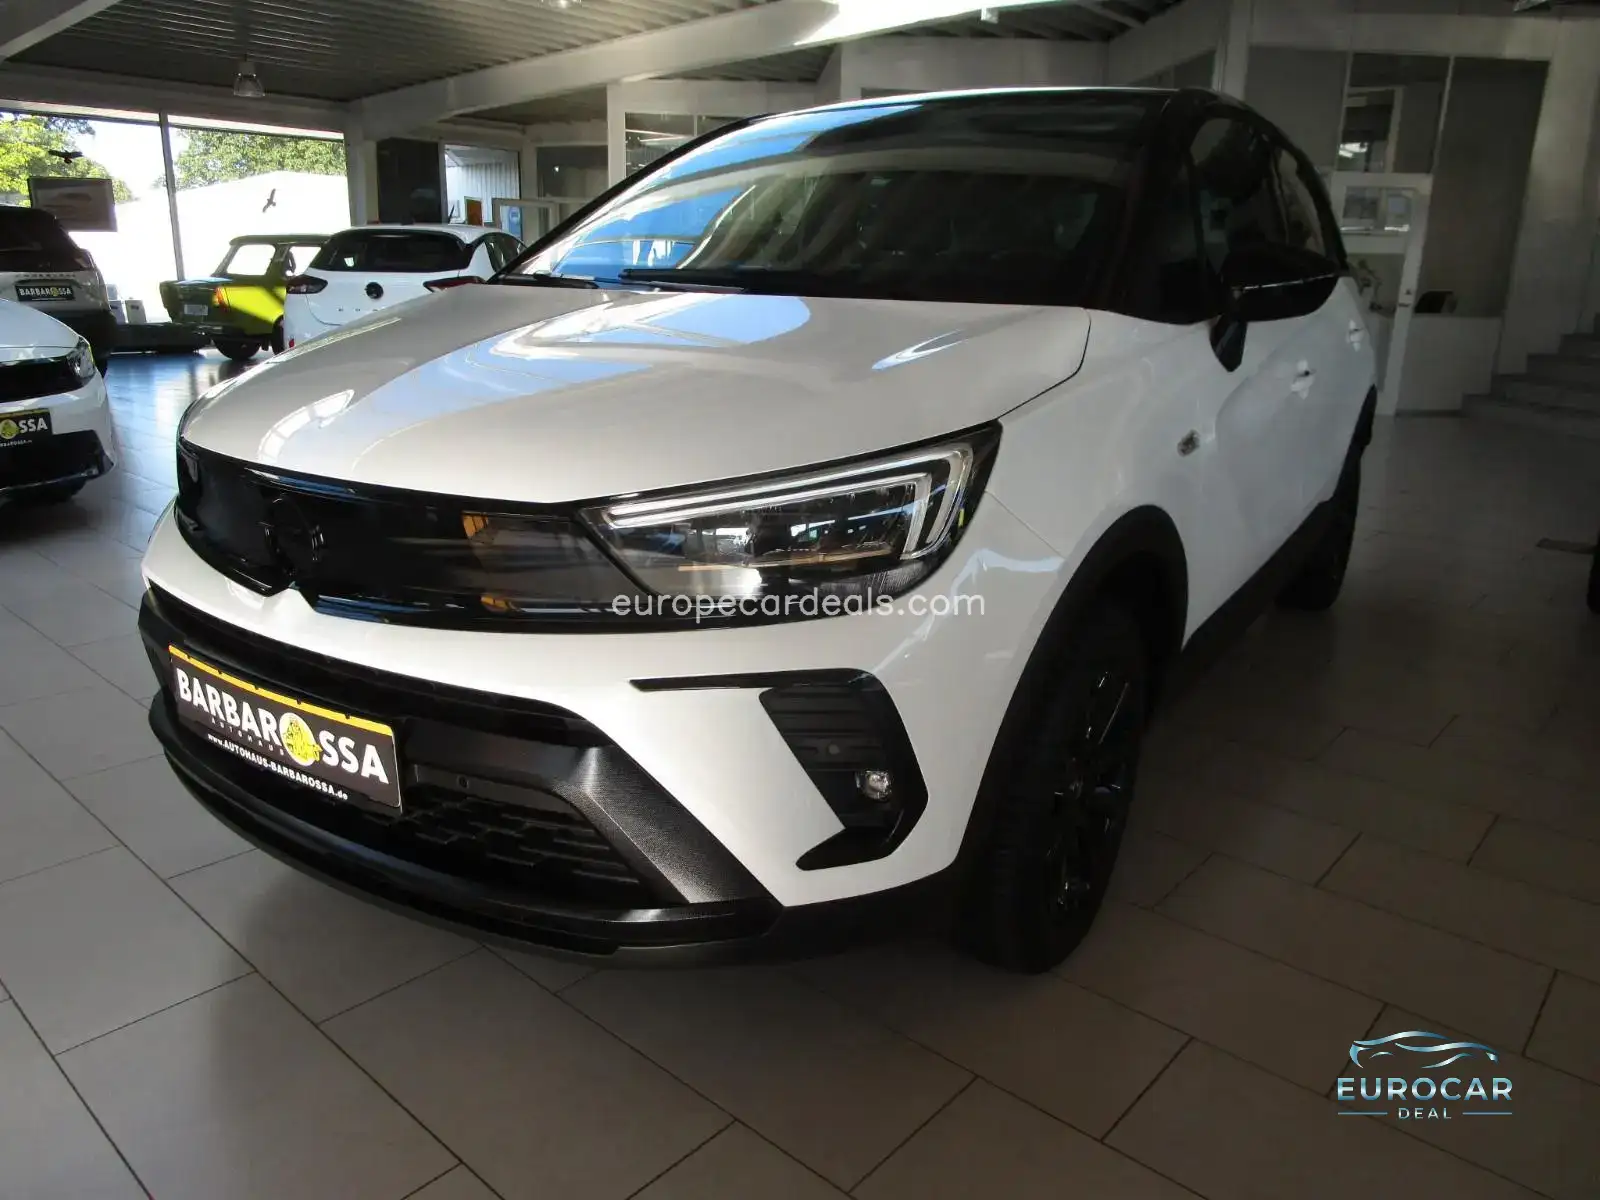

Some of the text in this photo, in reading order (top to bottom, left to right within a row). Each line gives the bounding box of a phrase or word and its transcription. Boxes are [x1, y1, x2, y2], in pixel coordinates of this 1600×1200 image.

[19, 287, 72, 297] BARBAROSSA
[176, 667, 390, 785] BARBAROSSA
[211, 718, 285, 756] AUTOHAUS
[207, 733, 349, 801] www.AUTOHAUS-BARBAROSSA.de
